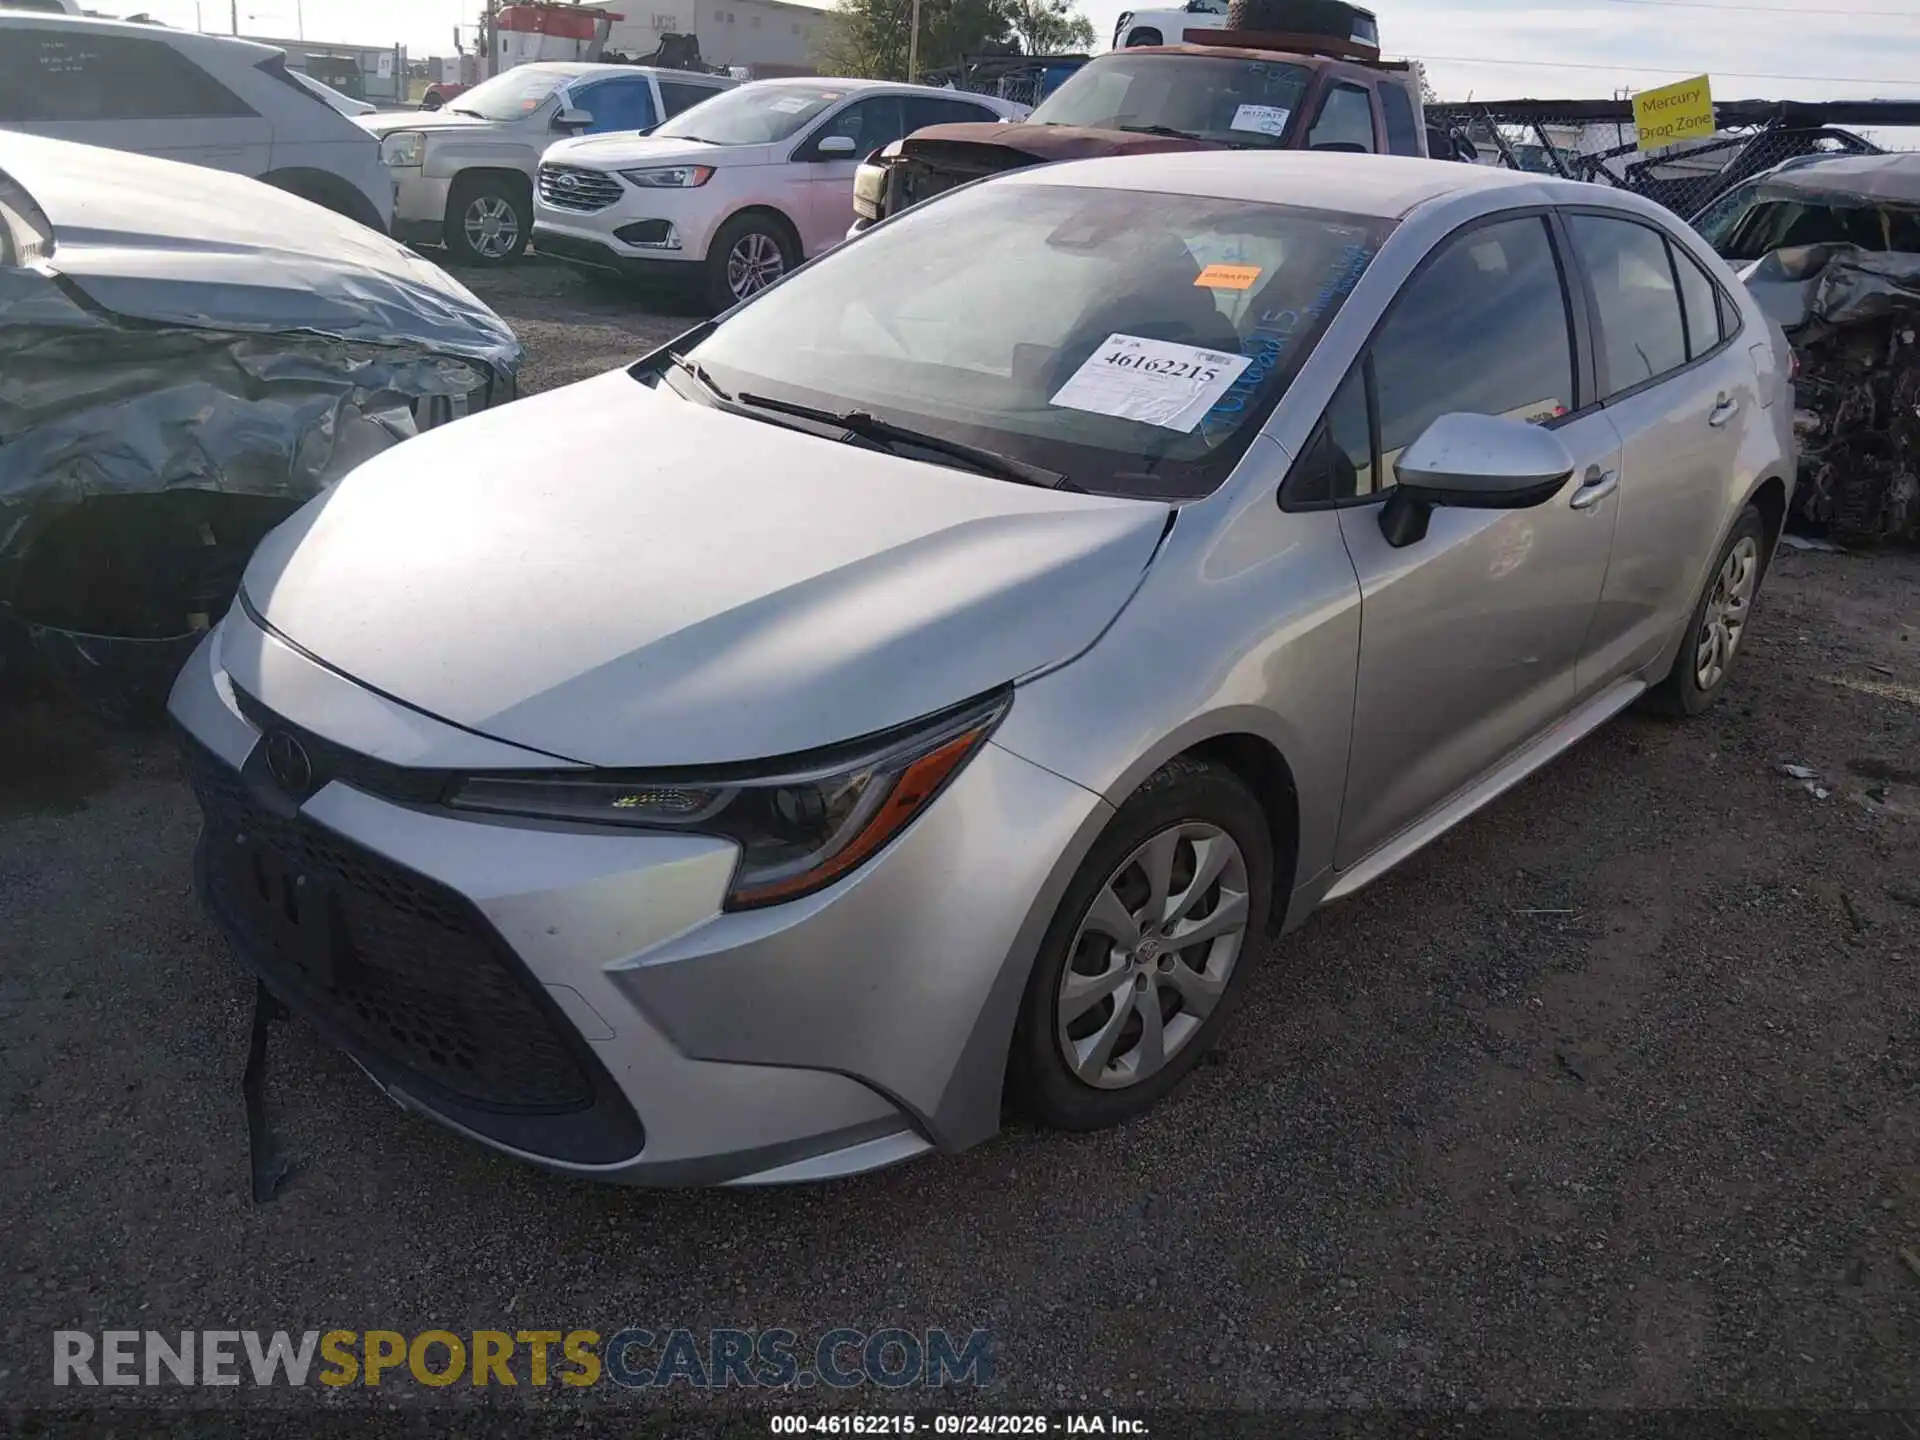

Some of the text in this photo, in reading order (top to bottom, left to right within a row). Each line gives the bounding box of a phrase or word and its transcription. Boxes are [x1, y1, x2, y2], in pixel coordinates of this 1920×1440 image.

[1642, 88, 1701, 112] Mercury
[1639, 114, 1711, 141] Drop Zone
[1104, 351, 1220, 383] 46162215
